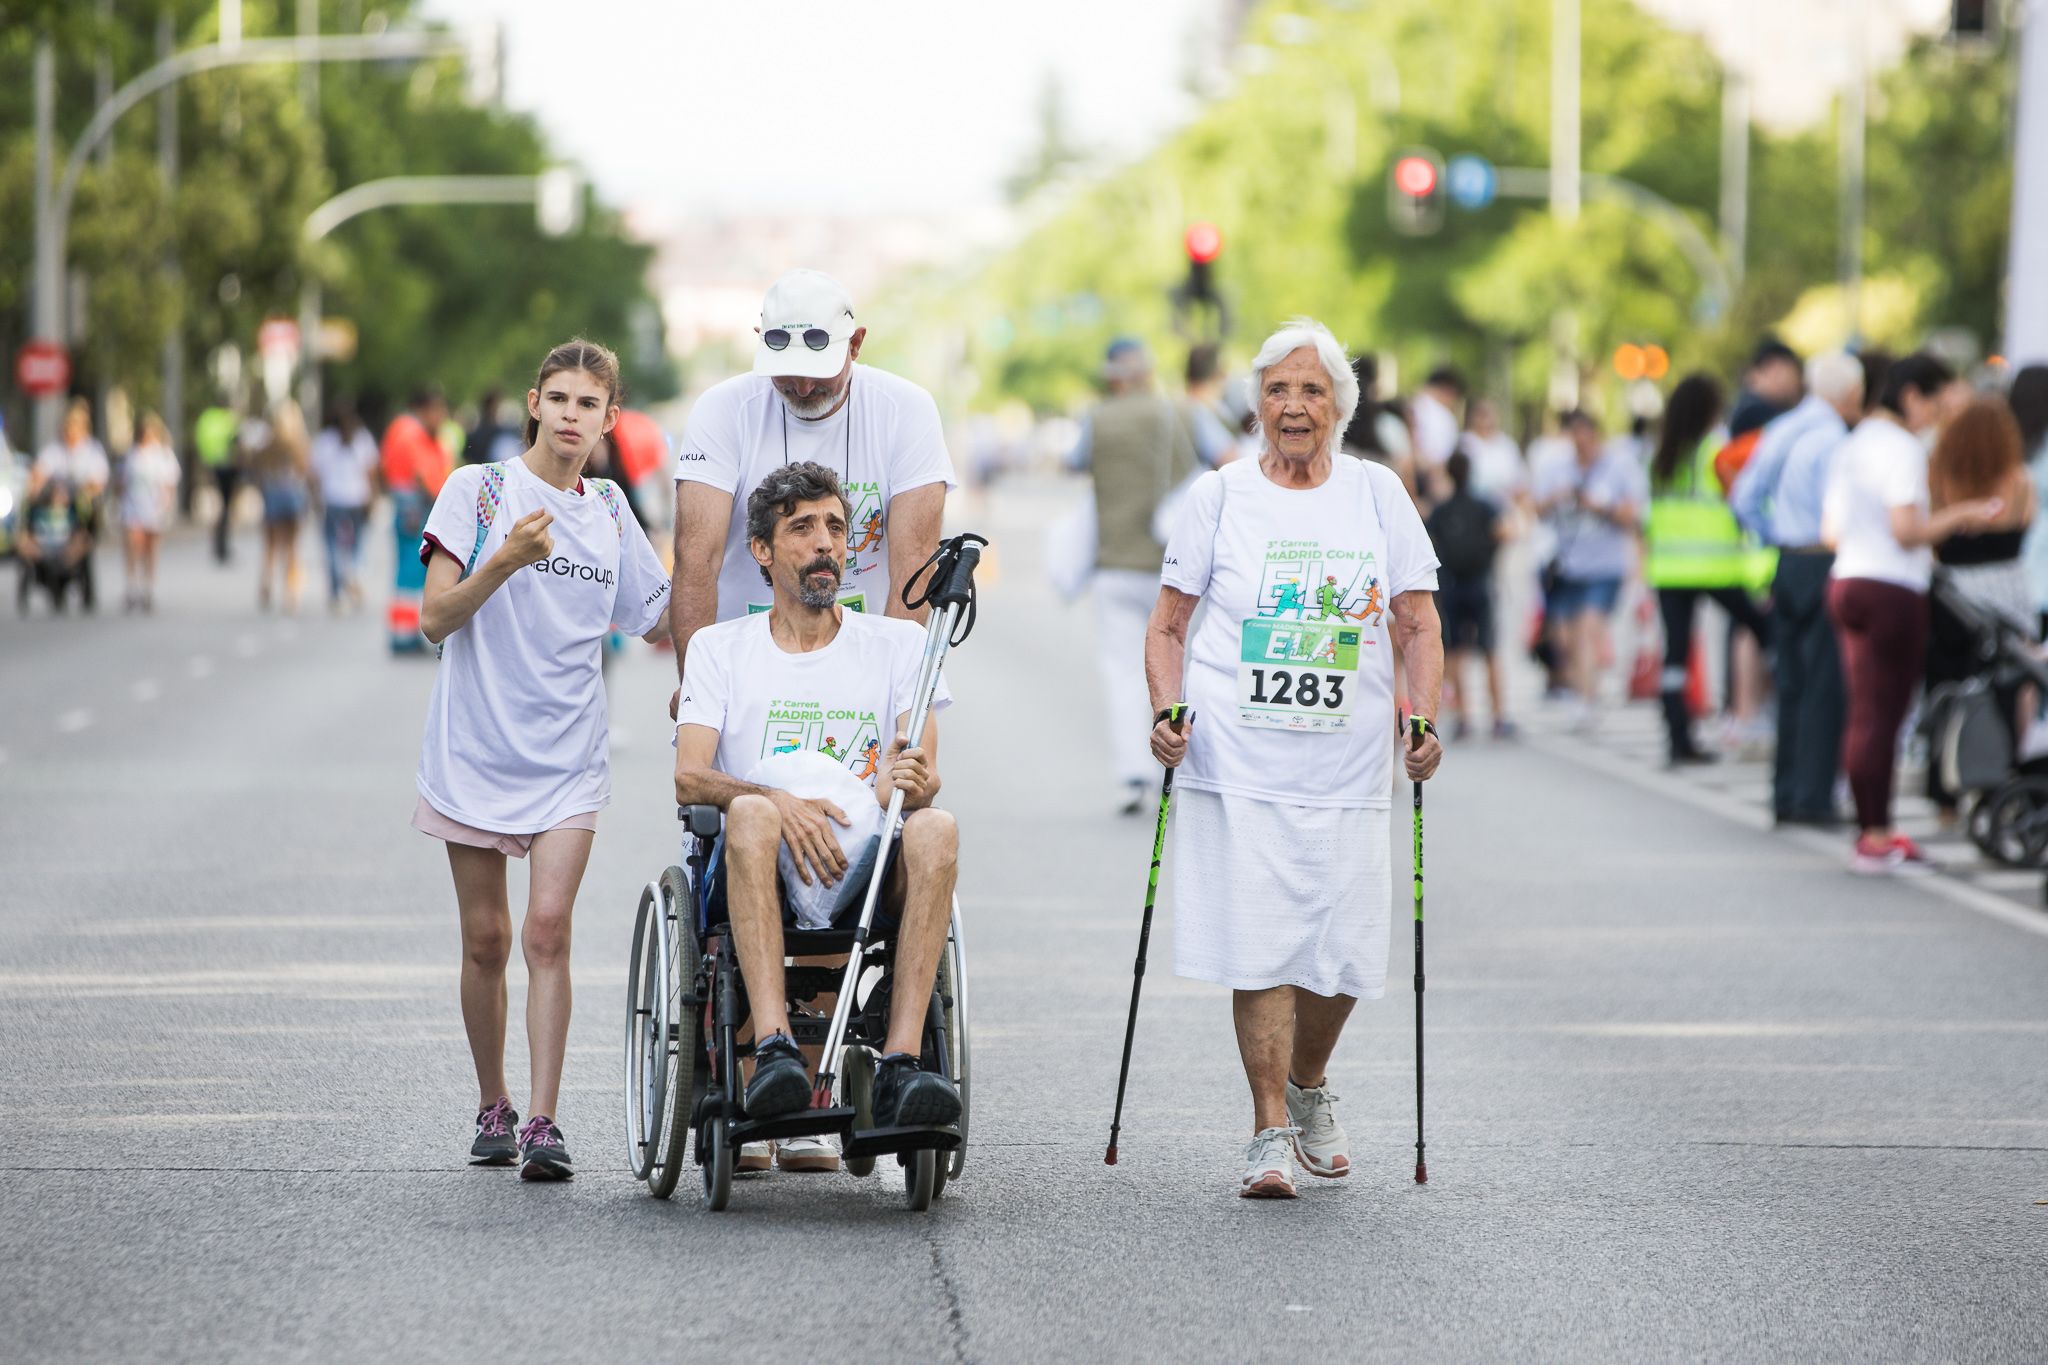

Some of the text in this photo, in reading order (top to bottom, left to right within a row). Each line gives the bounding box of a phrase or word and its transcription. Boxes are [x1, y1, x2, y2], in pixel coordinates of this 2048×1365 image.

[680, 453, 707, 462] UKUA
[1280, 539, 1319, 548] Carrera
[1265, 550, 1375, 560] MADRID CON LA
[1257, 560, 1384, 610] ELA
[1264, 630, 1337, 664] ELA
[1250, 668, 1346, 709] 1283
[784, 699, 820, 708] Carrera
[768, 709, 876, 721] MADRID CON LA
